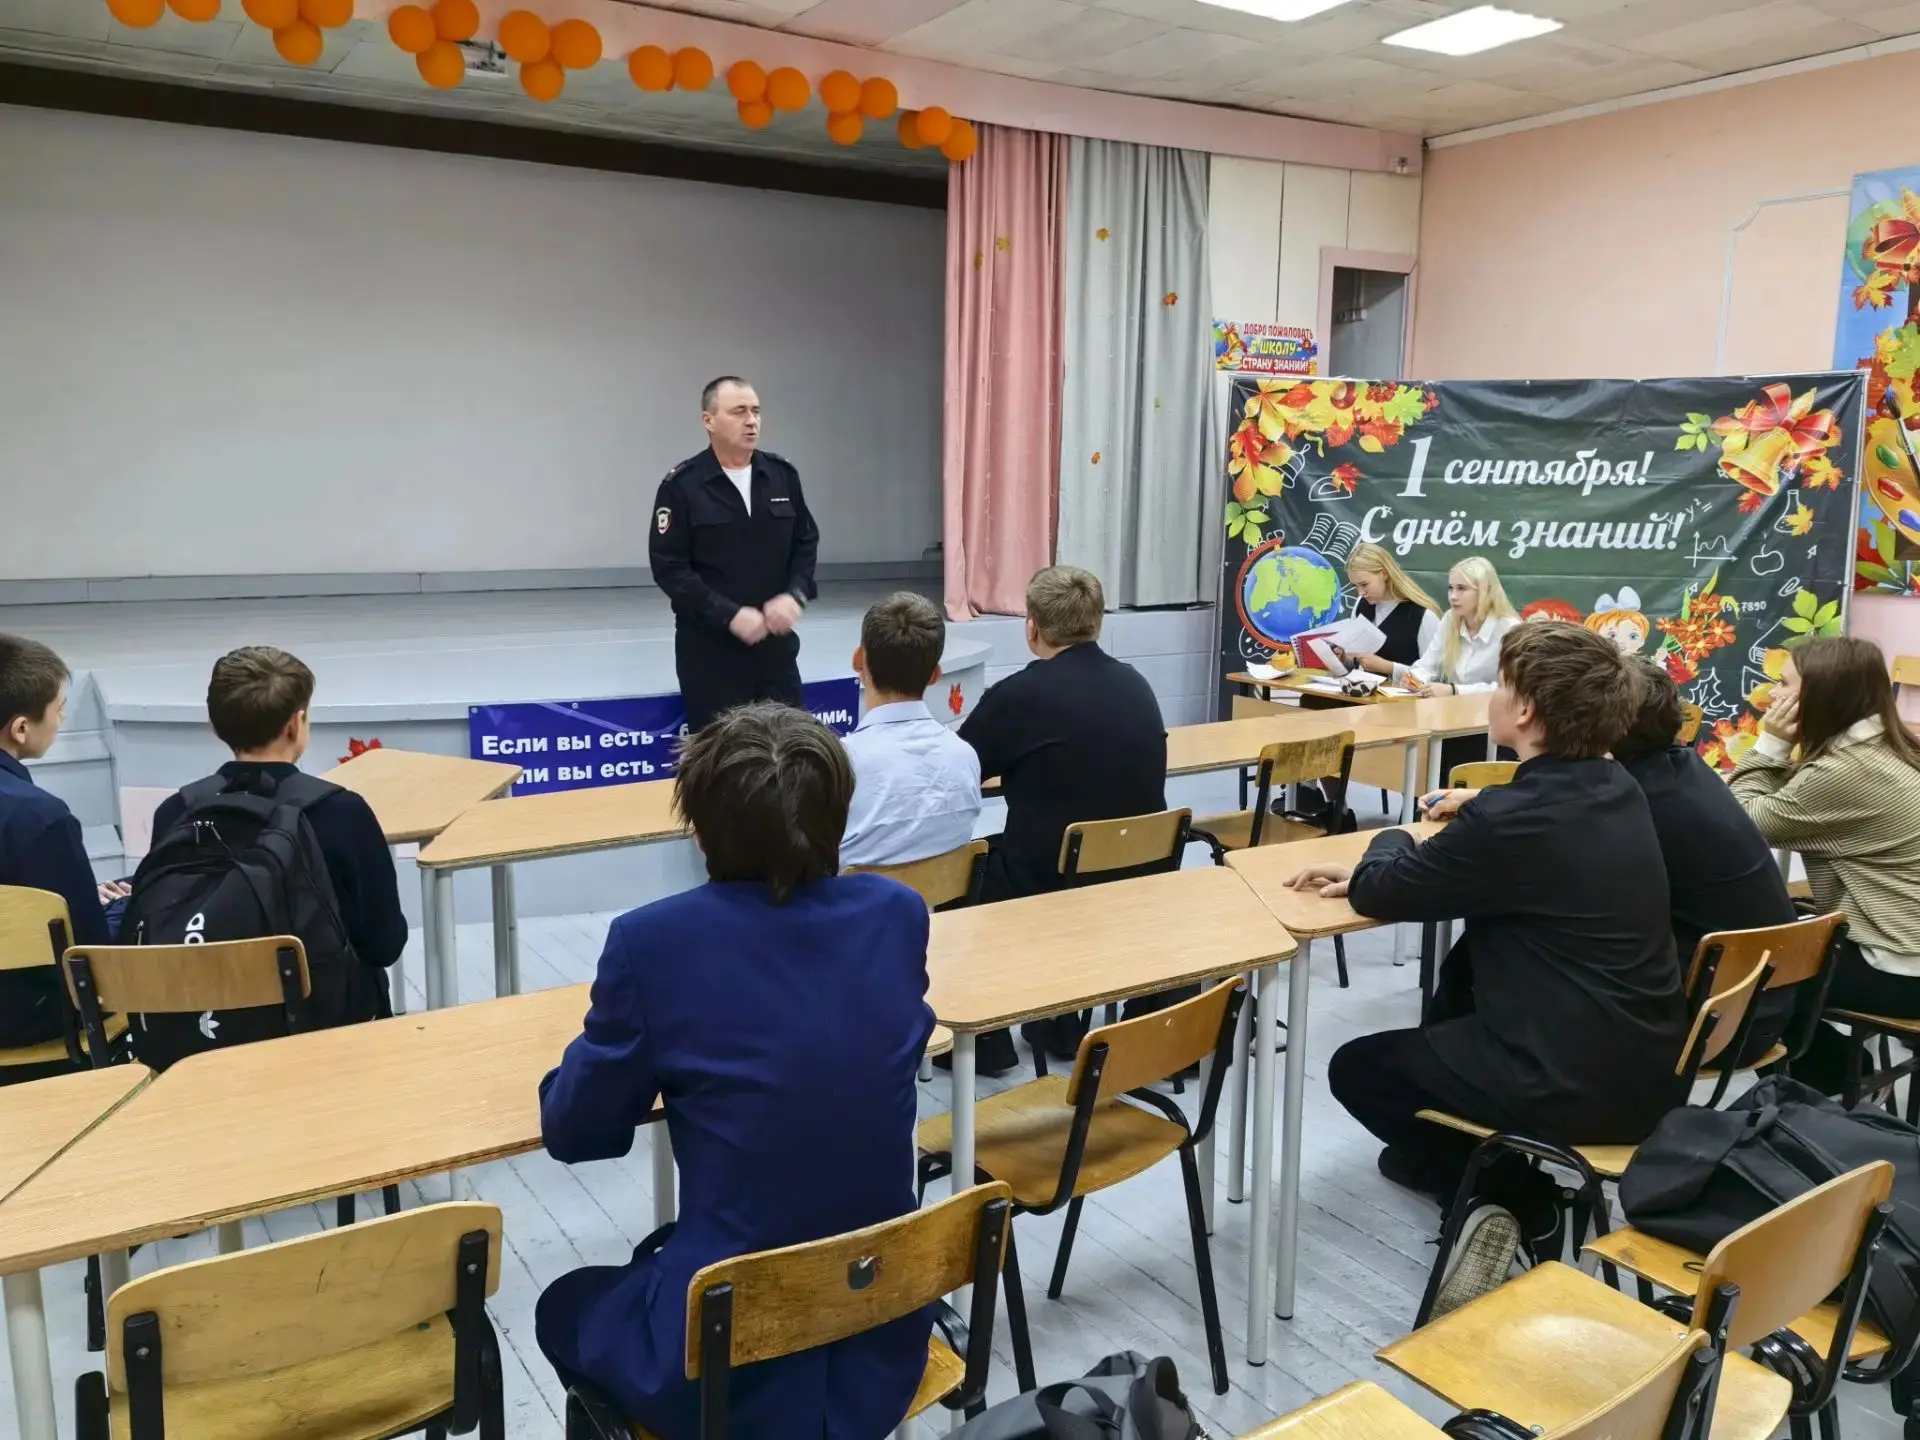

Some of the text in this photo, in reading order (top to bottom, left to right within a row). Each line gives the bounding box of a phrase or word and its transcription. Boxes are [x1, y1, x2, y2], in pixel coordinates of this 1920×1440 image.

[1244, 323, 1314, 339] ДОБРО ПОЖАЛОВАТЬ
[1242, 357, 1309, 372] СТРАНУ ЗНАНИЙ!
[1396, 435, 1655, 497] 1 сентября!
[1361, 505, 1684, 559] С днём знаний!
[482, 735, 548, 755] Если
[557, 735, 591, 751] вы
[599, 731, 654, 748] есть
[516, 767, 549, 784] ли
[558, 765, 592, 781] вы
[600, 761, 655, 778] есть
